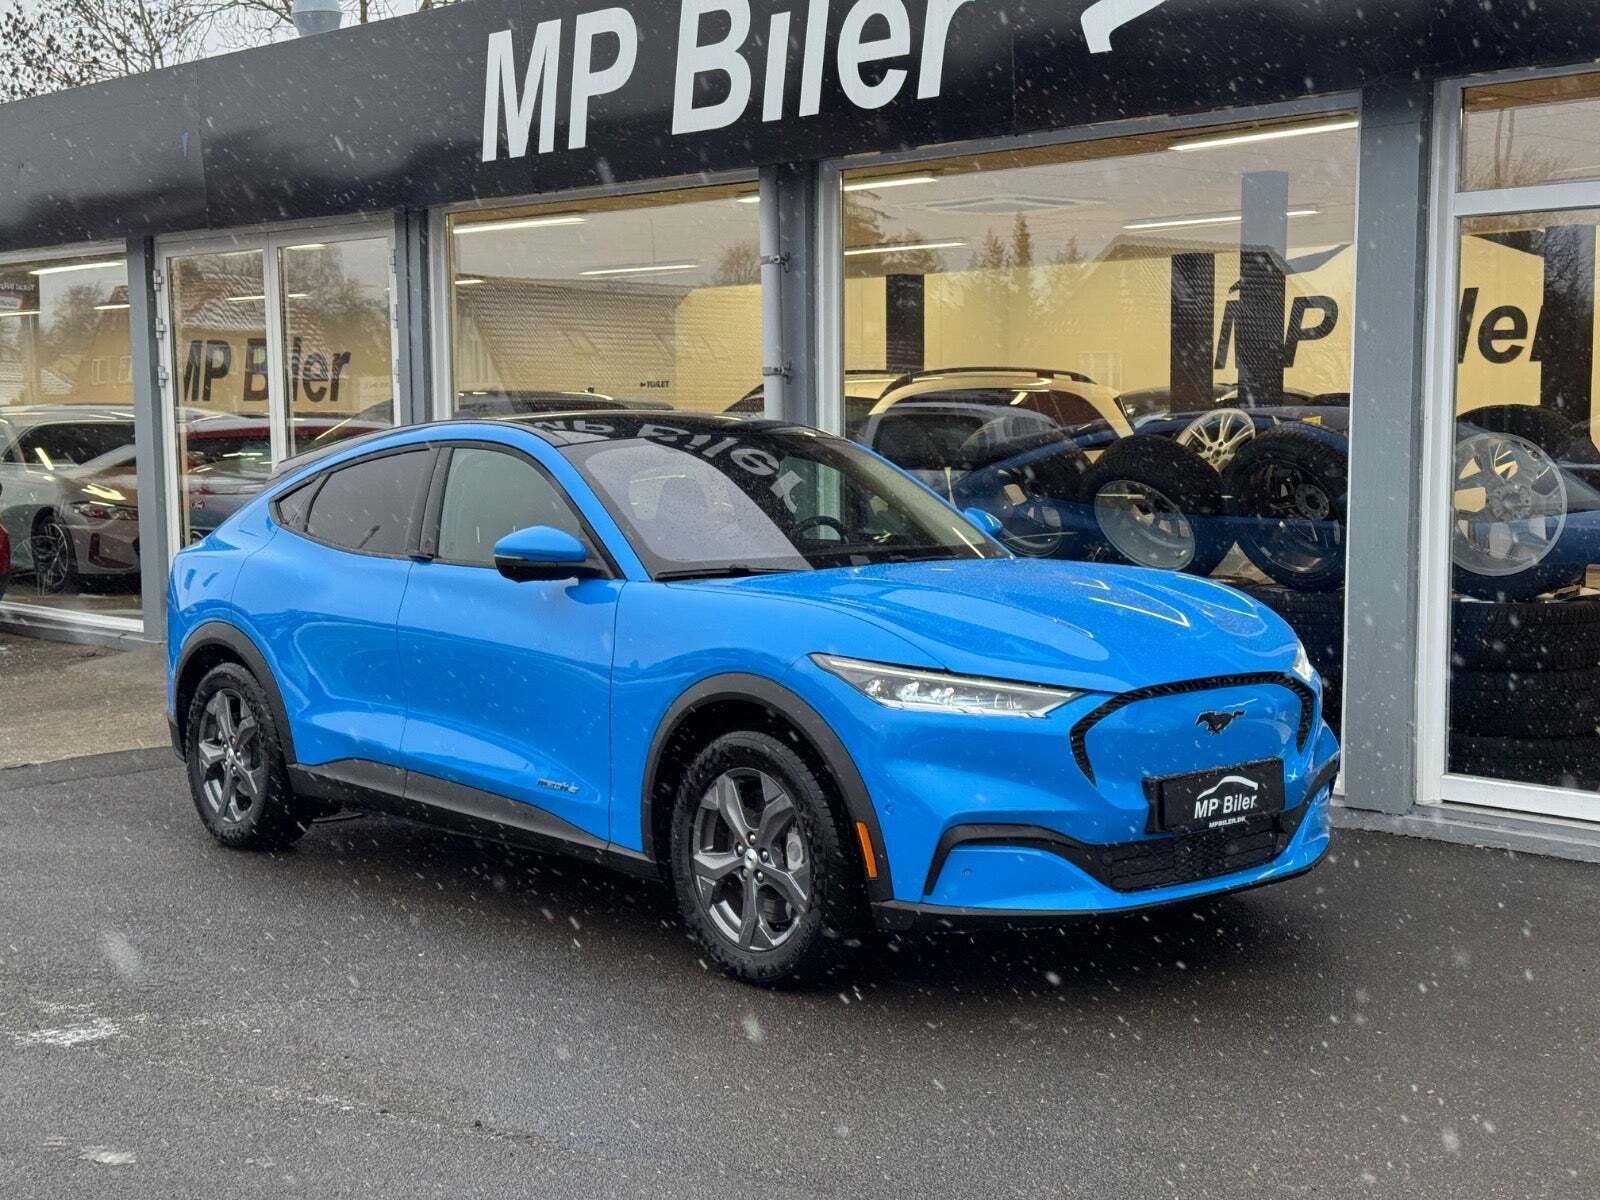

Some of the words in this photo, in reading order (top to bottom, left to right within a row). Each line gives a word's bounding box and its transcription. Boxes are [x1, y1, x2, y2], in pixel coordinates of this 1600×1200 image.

[482, 7, 638, 163] MP
[671, 0, 977, 136] Biler
[243, 336, 352, 403] Bler
[1193, 798, 1219, 819] MP
[1223, 793, 1258, 814] Biler
[1208, 815, 1247, 828] MPBILER.DK
